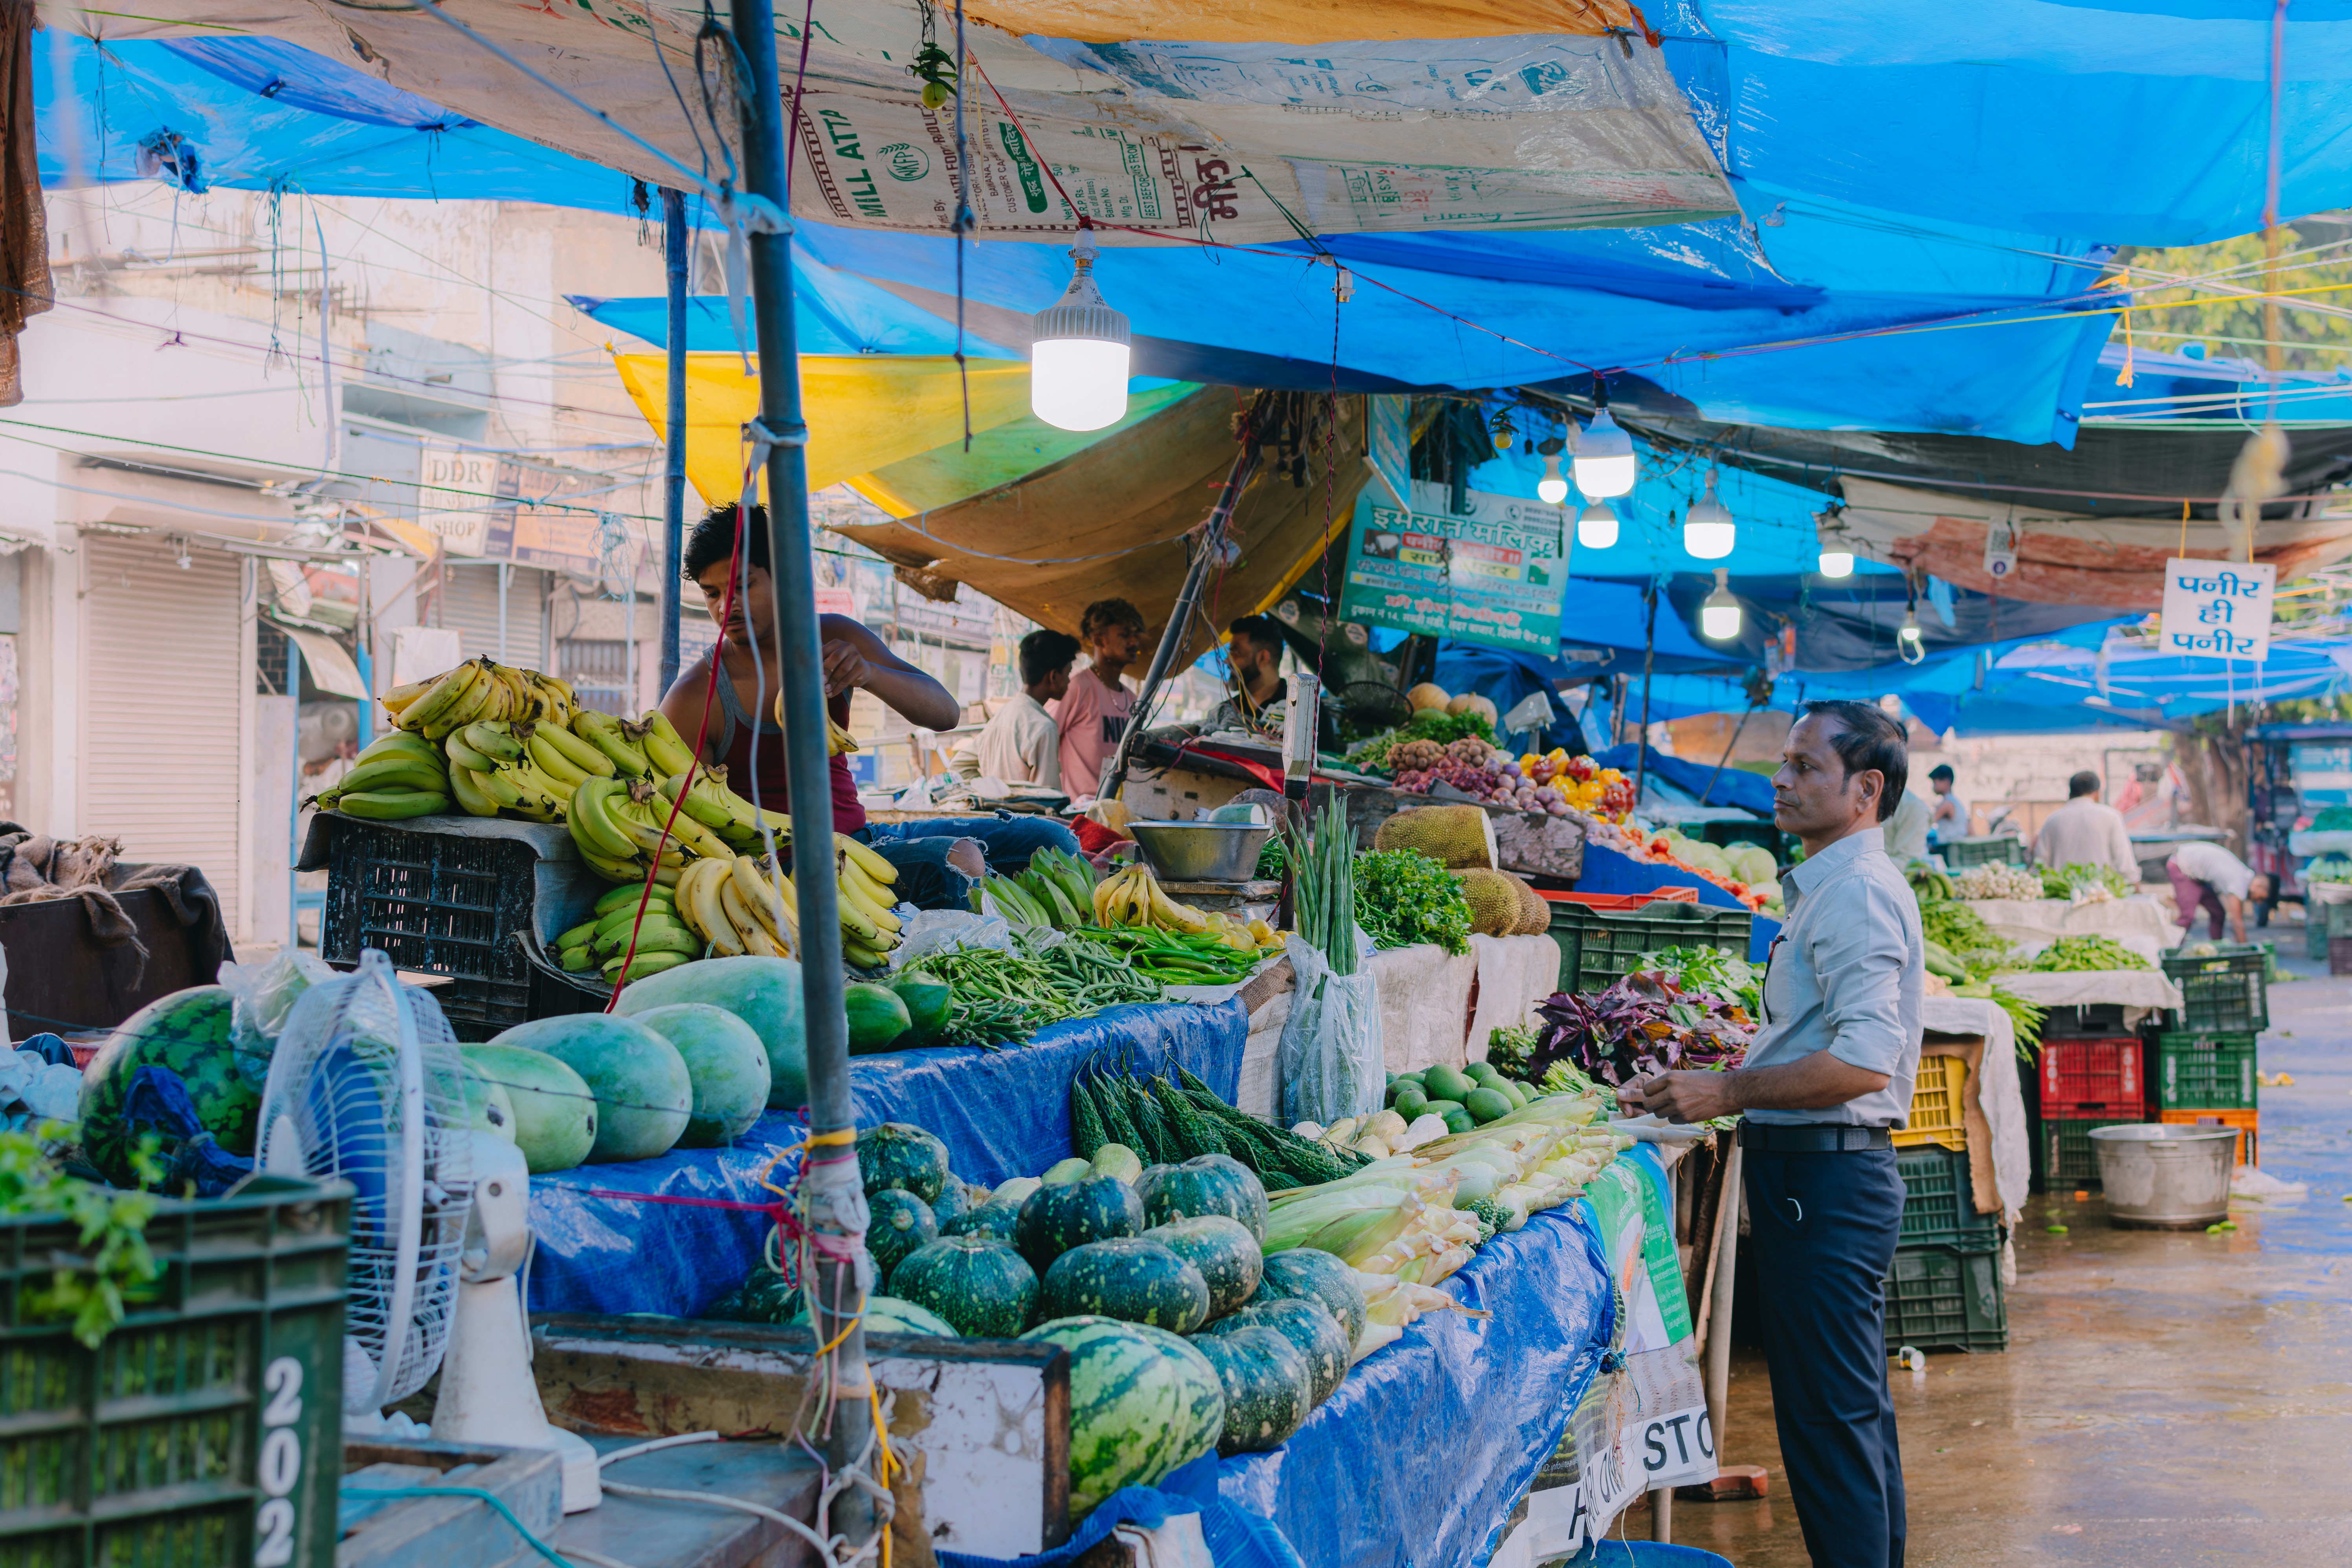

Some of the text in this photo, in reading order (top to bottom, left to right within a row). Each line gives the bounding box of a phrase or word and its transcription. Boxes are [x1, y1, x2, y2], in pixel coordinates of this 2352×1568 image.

[892, 151, 920, 176] NKFP
[845, 169, 888, 217] MILL
[999, 175, 1017, 213] CUSTOMER
[1026, 180, 1042, 196] शुद्ध
[1075, 187, 1085, 198] Rs.
[1139, 176, 1152, 201] BEFOR
[1063, 207, 1074, 220] Net
[1101, 186, 1114, 218] Batch No.
[1121, 206, 1132, 218] Mfg
[1144, 201, 1155, 216] BEST
[432, 460, 483, 484] DDR
[434, 521, 476, 536] SHOP
[2177, 572, 2263, 598] पनीर
[2198, 599, 2236, 624] ही
[2171, 629, 2258, 654] पनीर
[254, 1355, 304, 1568] 202
